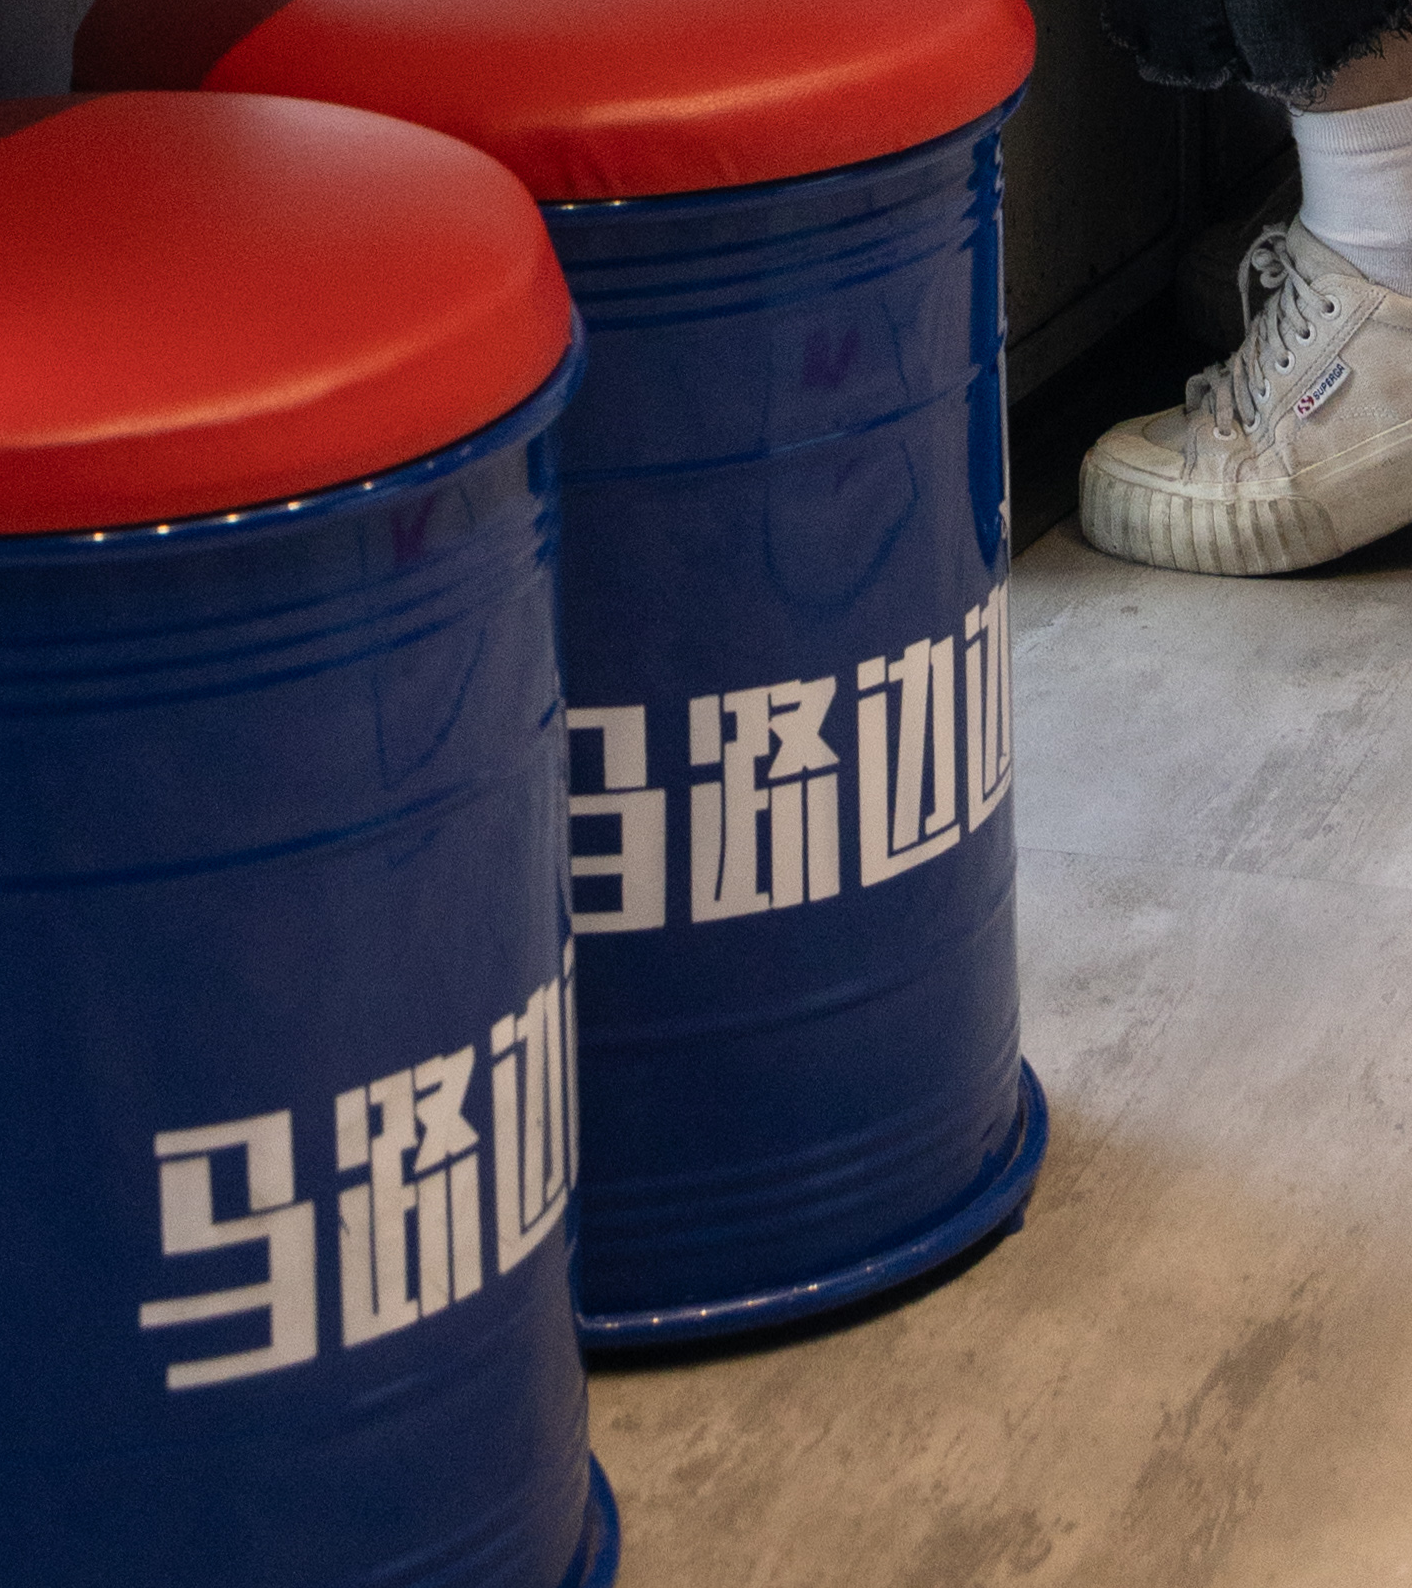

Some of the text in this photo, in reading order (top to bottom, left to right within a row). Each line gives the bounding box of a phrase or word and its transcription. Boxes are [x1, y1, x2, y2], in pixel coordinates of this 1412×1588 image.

[1312, 363, 1345, 400] SUPERGA
[138, 936, 580, 1391] 马路边
